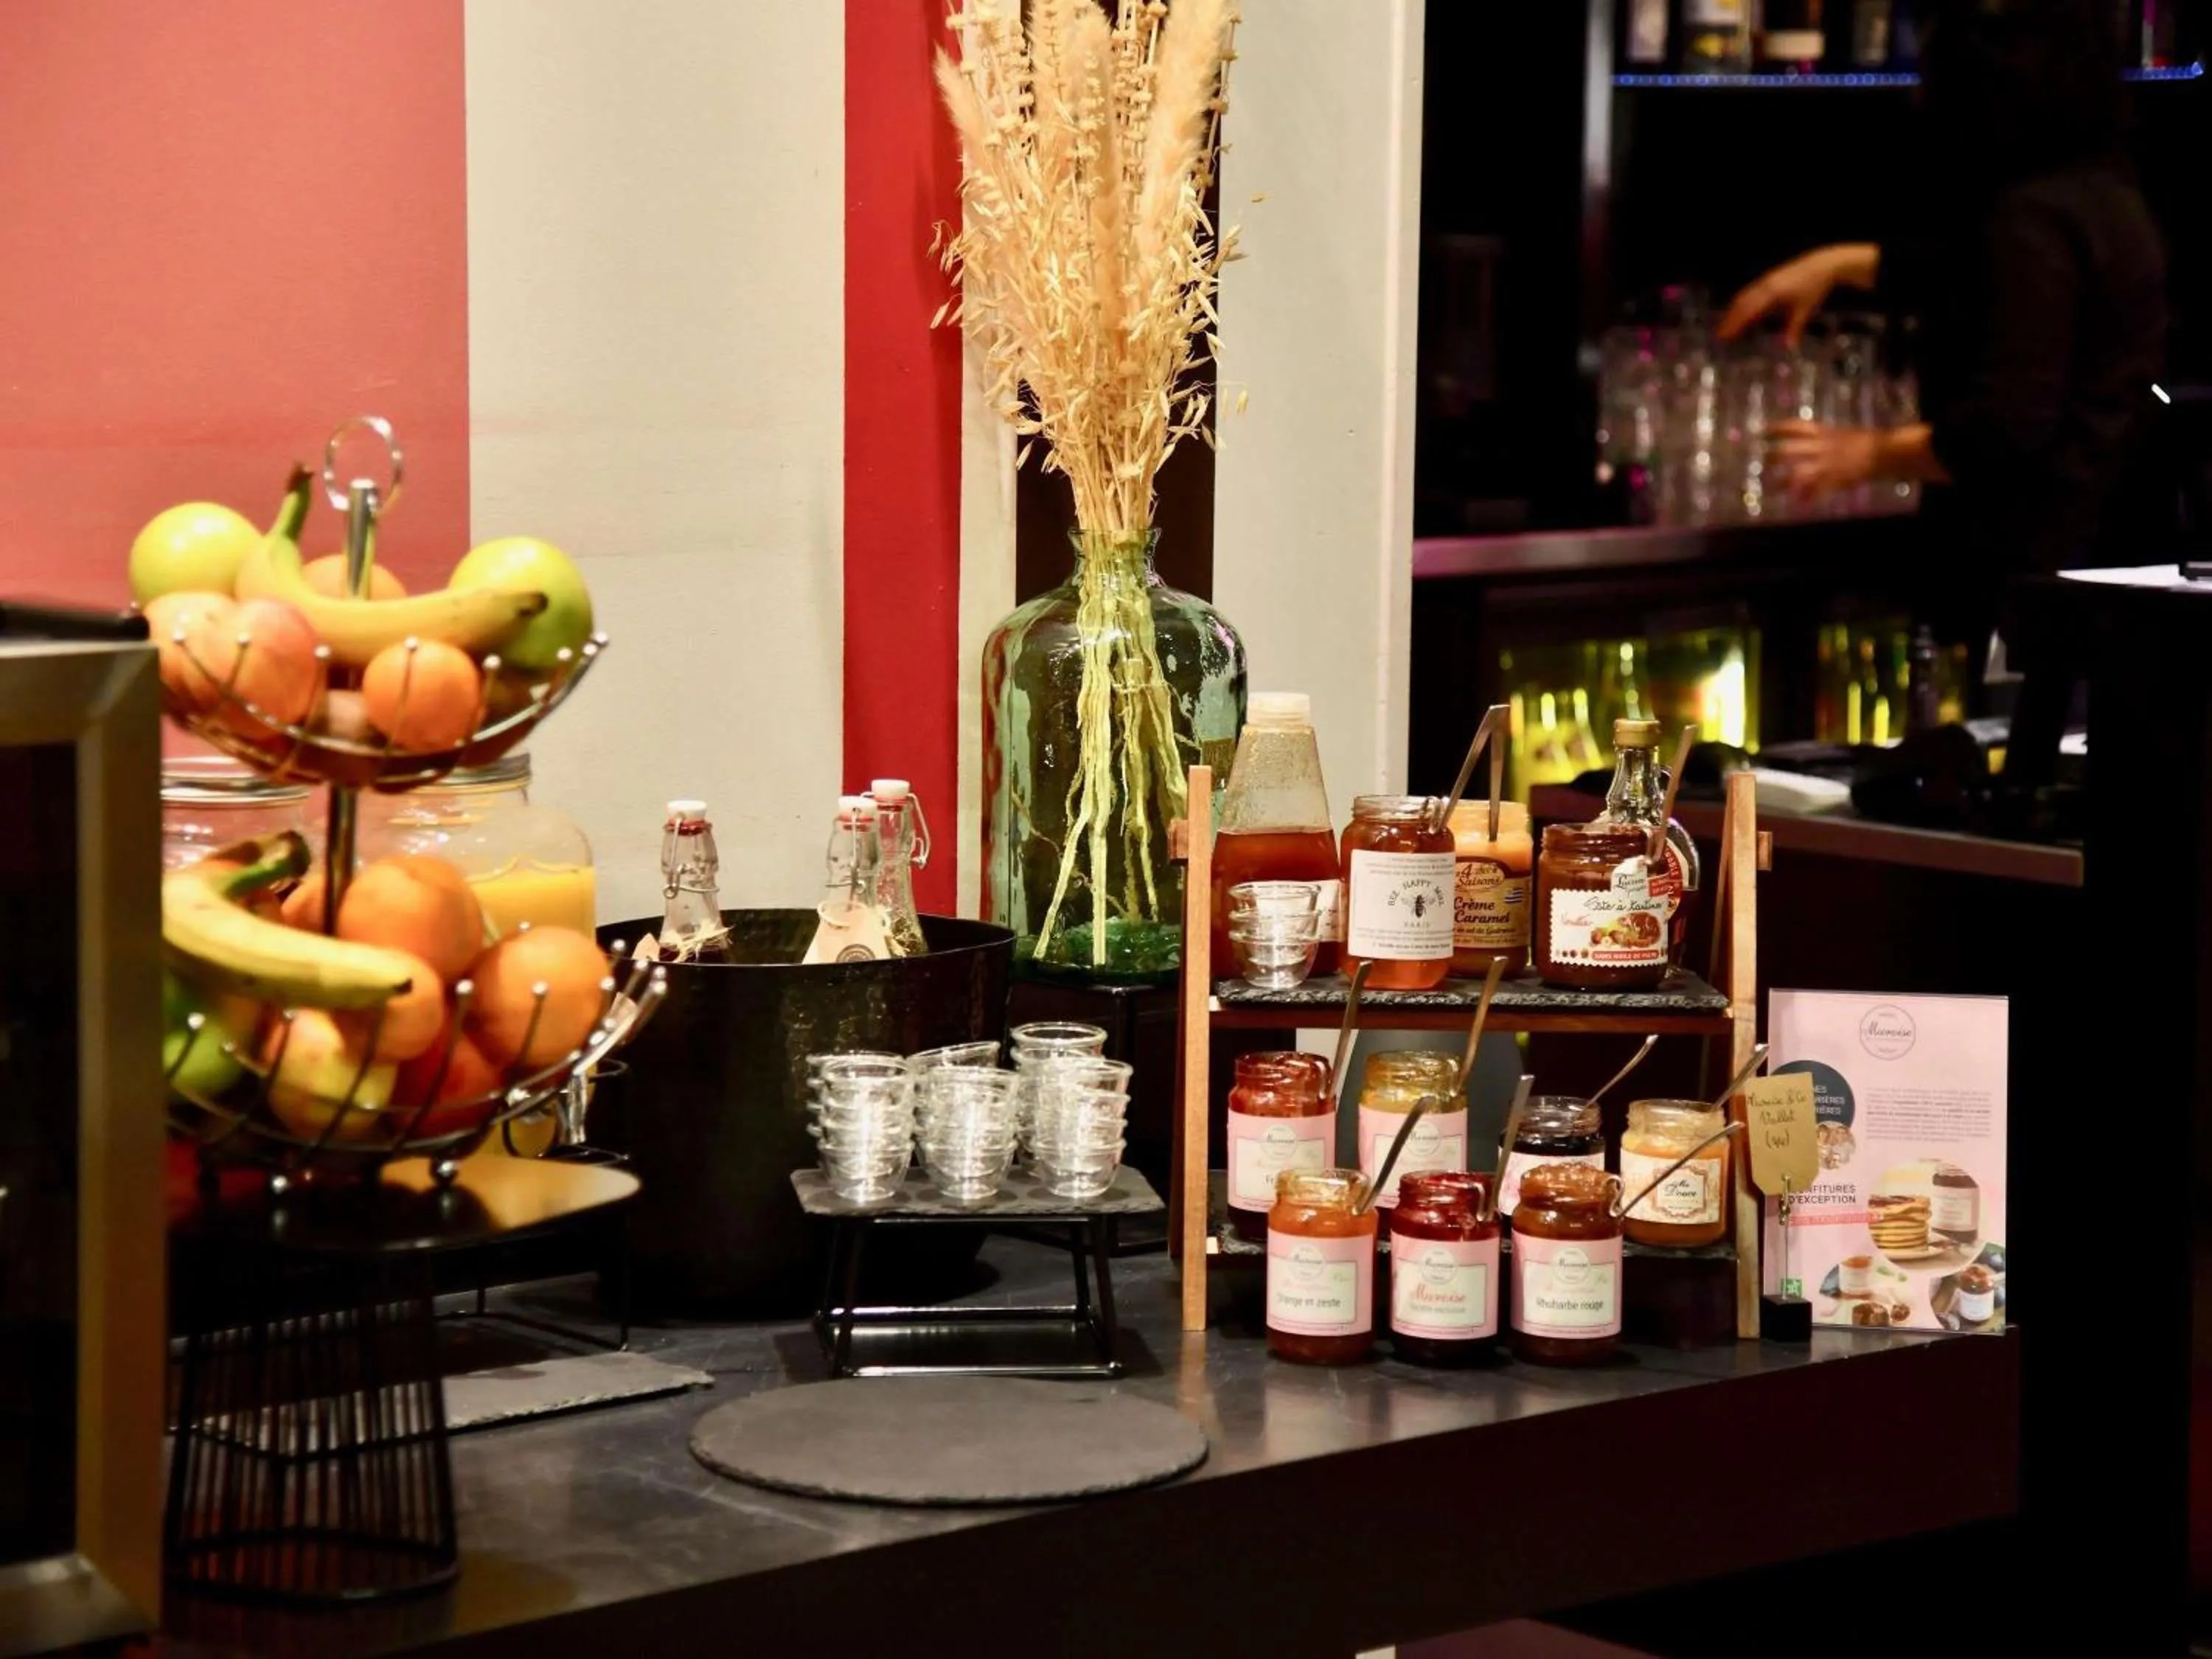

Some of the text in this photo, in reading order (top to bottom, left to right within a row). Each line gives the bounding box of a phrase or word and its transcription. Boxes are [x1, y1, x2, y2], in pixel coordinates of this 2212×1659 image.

[1402, 879, 1430, 891] HAPPY
[1453, 896, 1495, 911] Crème
[1454, 909, 1510, 924] Caramel
[1789, 1195, 1857, 1205] D'EXCEPTION
[1536, 1296, 1604, 1312] Rhubarbe rouge
